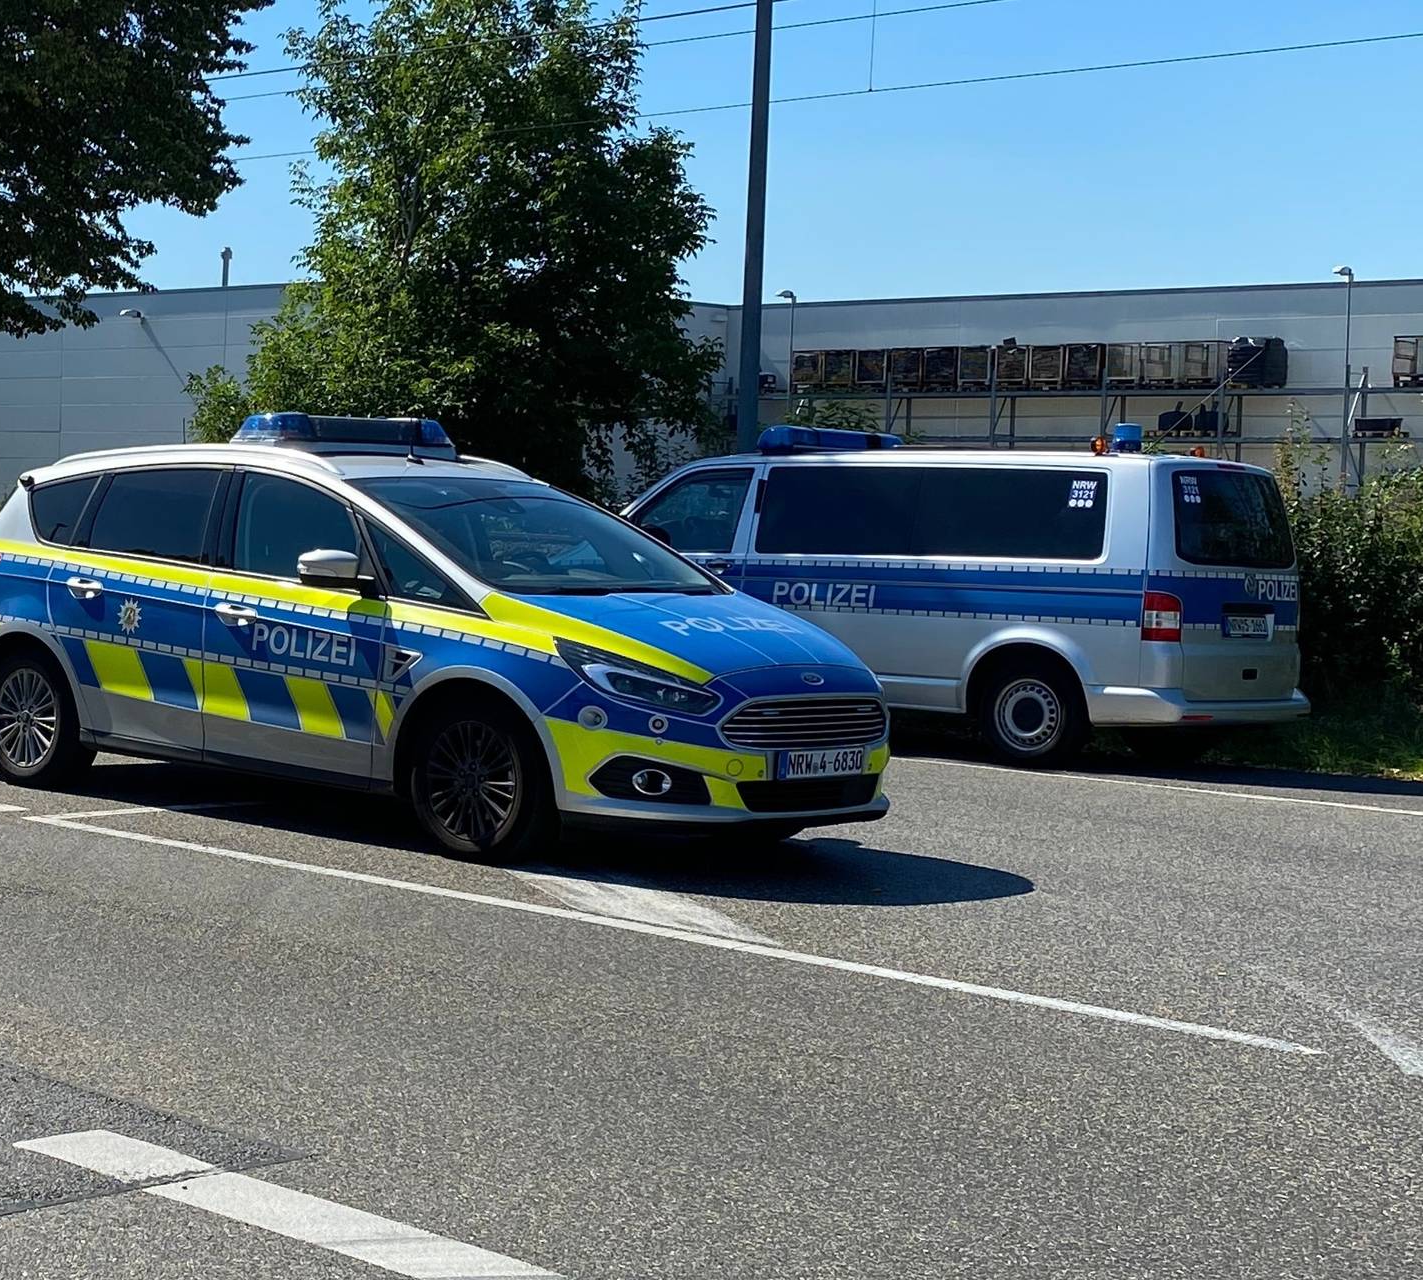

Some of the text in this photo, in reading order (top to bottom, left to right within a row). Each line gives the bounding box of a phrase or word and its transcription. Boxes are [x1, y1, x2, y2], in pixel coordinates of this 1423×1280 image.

[1071, 489, 1095, 499] 3121
[1072, 480, 1097, 490] NRW
[1182, 485, 1200, 494] 3121
[772, 581, 876, 608] POLIZEI
[1257, 579, 1298, 602] POLIZEI
[658, 615, 804, 637] POLIZEI
[251, 622, 357, 667] POLIZEI
[787, 750, 863, 776] NRW 4-6830
